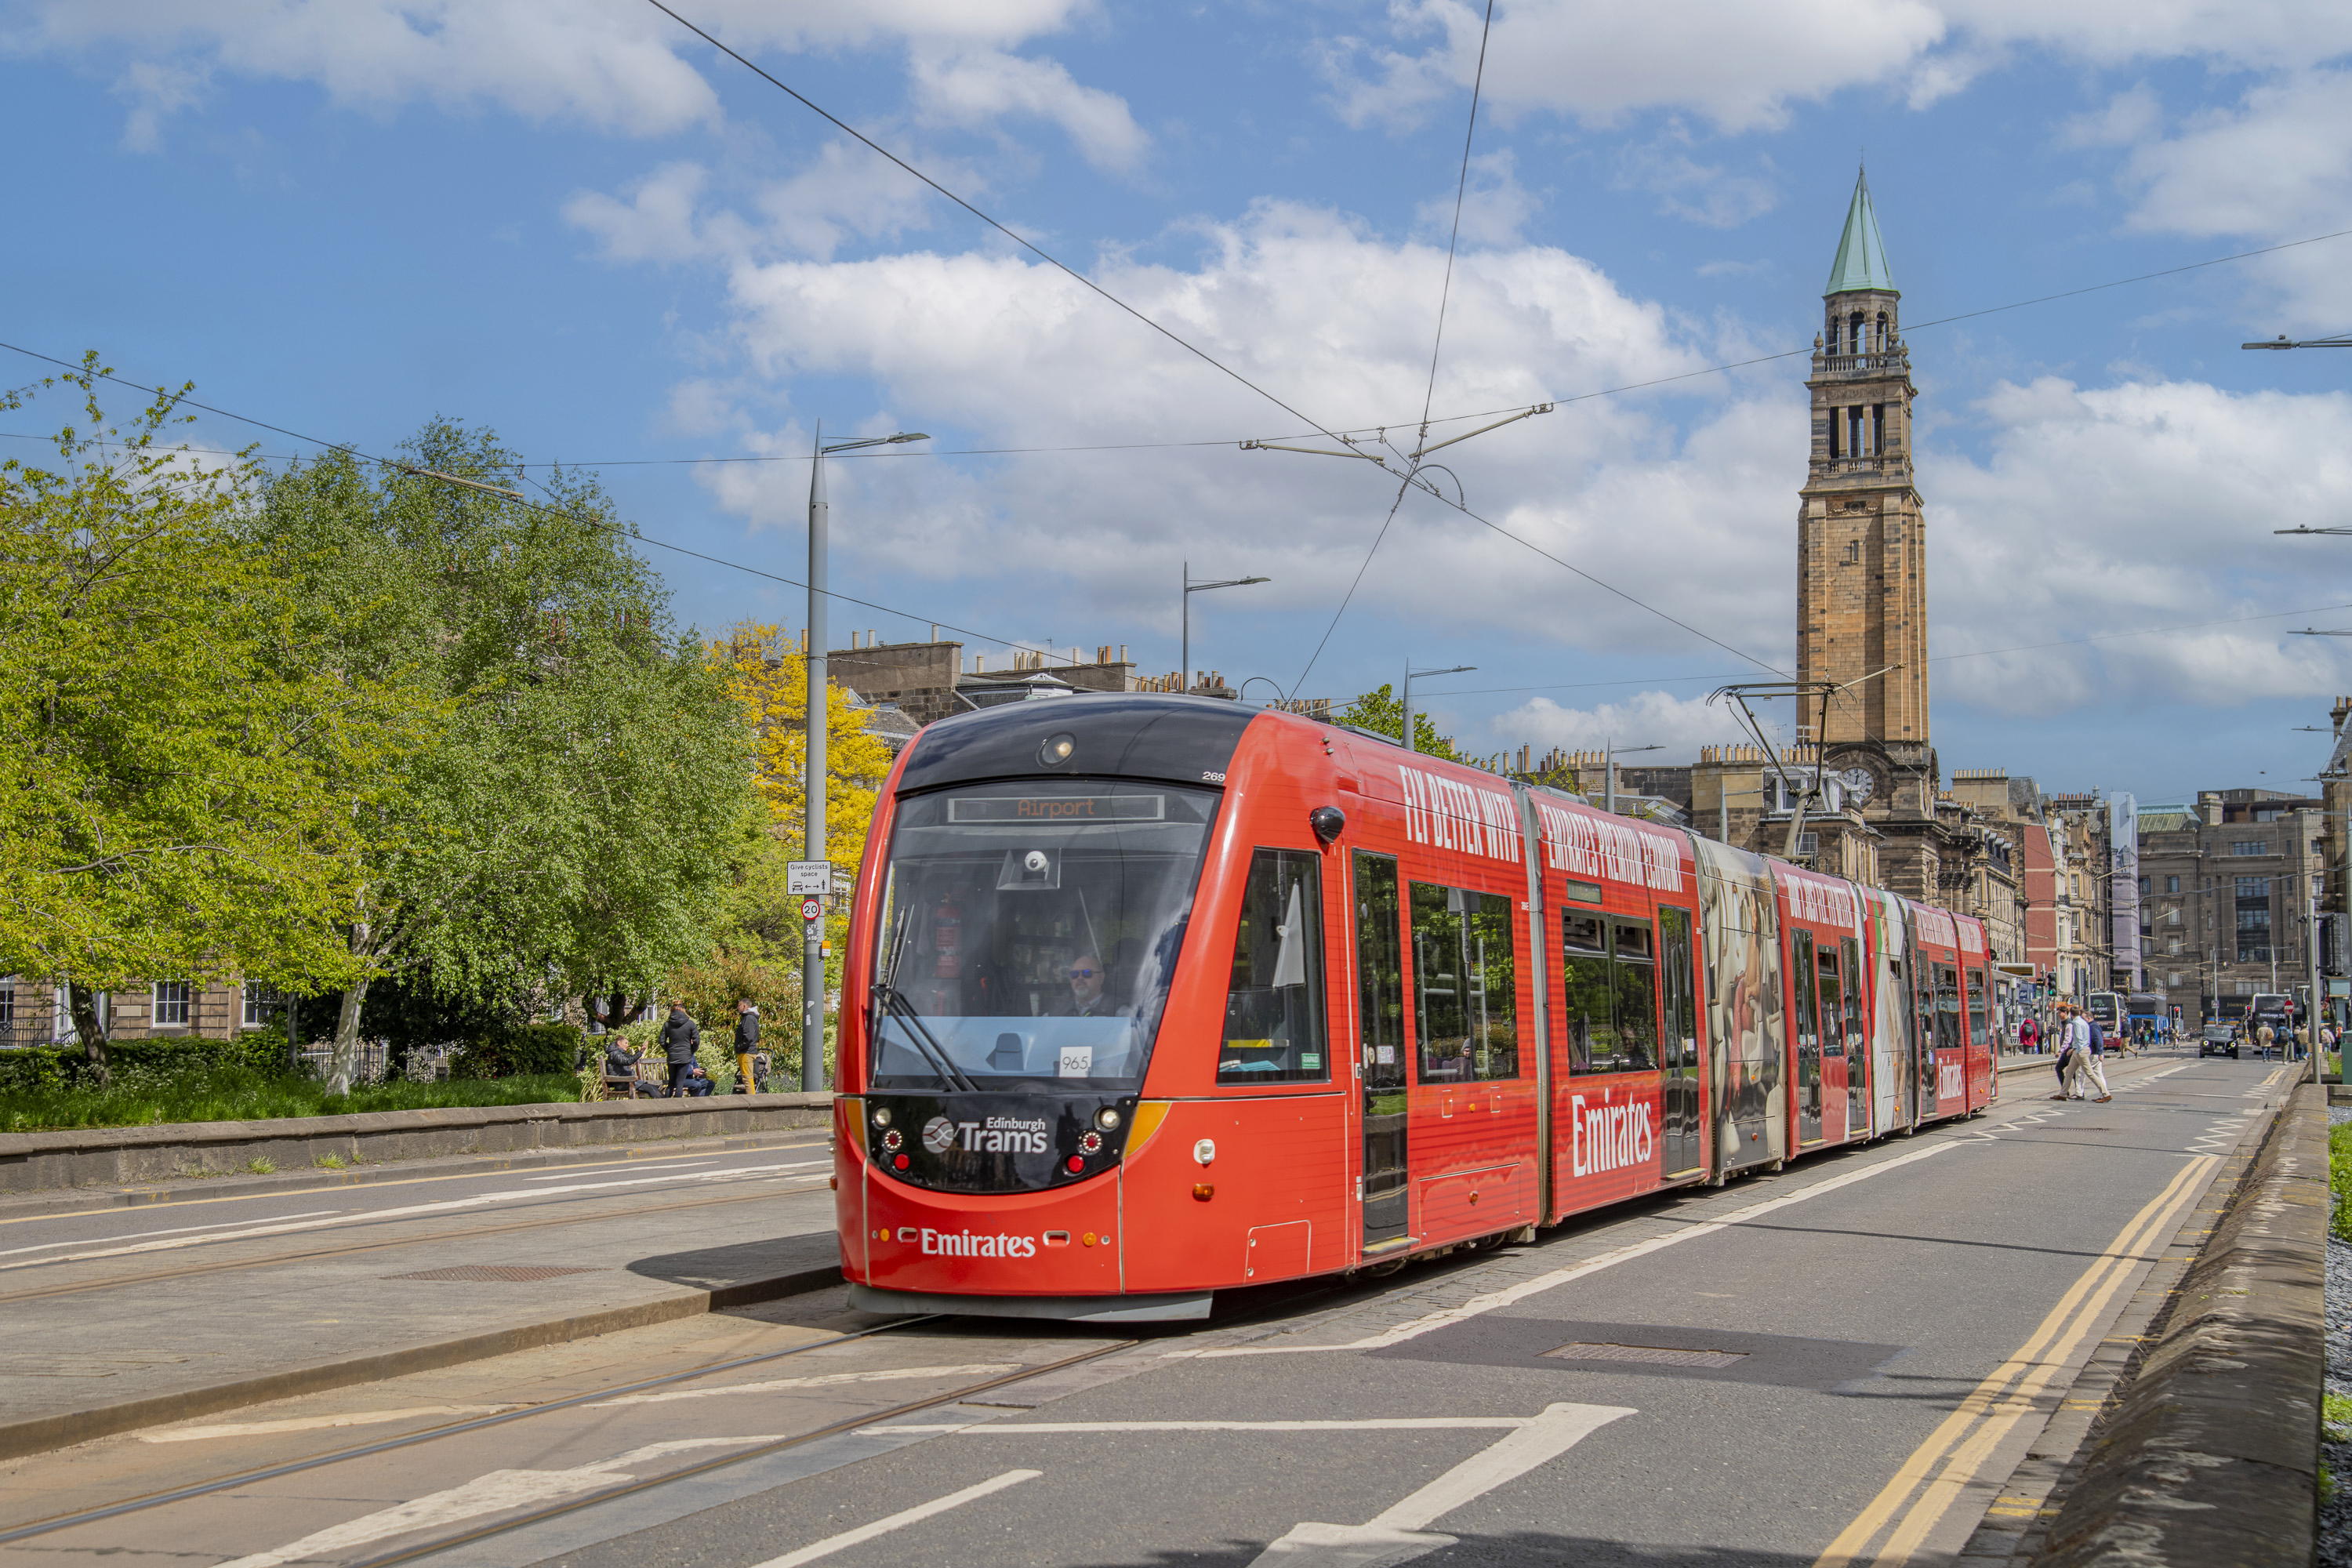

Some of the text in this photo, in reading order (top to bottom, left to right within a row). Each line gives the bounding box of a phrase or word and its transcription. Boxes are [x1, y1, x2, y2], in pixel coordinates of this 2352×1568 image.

[1202, 771, 1226, 782] 269
[1018, 798, 1094, 818] Airport
[1398, 764, 1519, 863] FLY BETTER WITH
[1540, 804, 1683, 893] EMIRATES PREMIUM ECONOMY
[1062, 1056, 1088, 1069] 965
[958, 1121, 1048, 1153] Trams
[986, 1116, 1046, 1132] Edinburgh
[1571, 1087, 1652, 1178] Emirates
[921, 1229, 1036, 1258] Emirates
